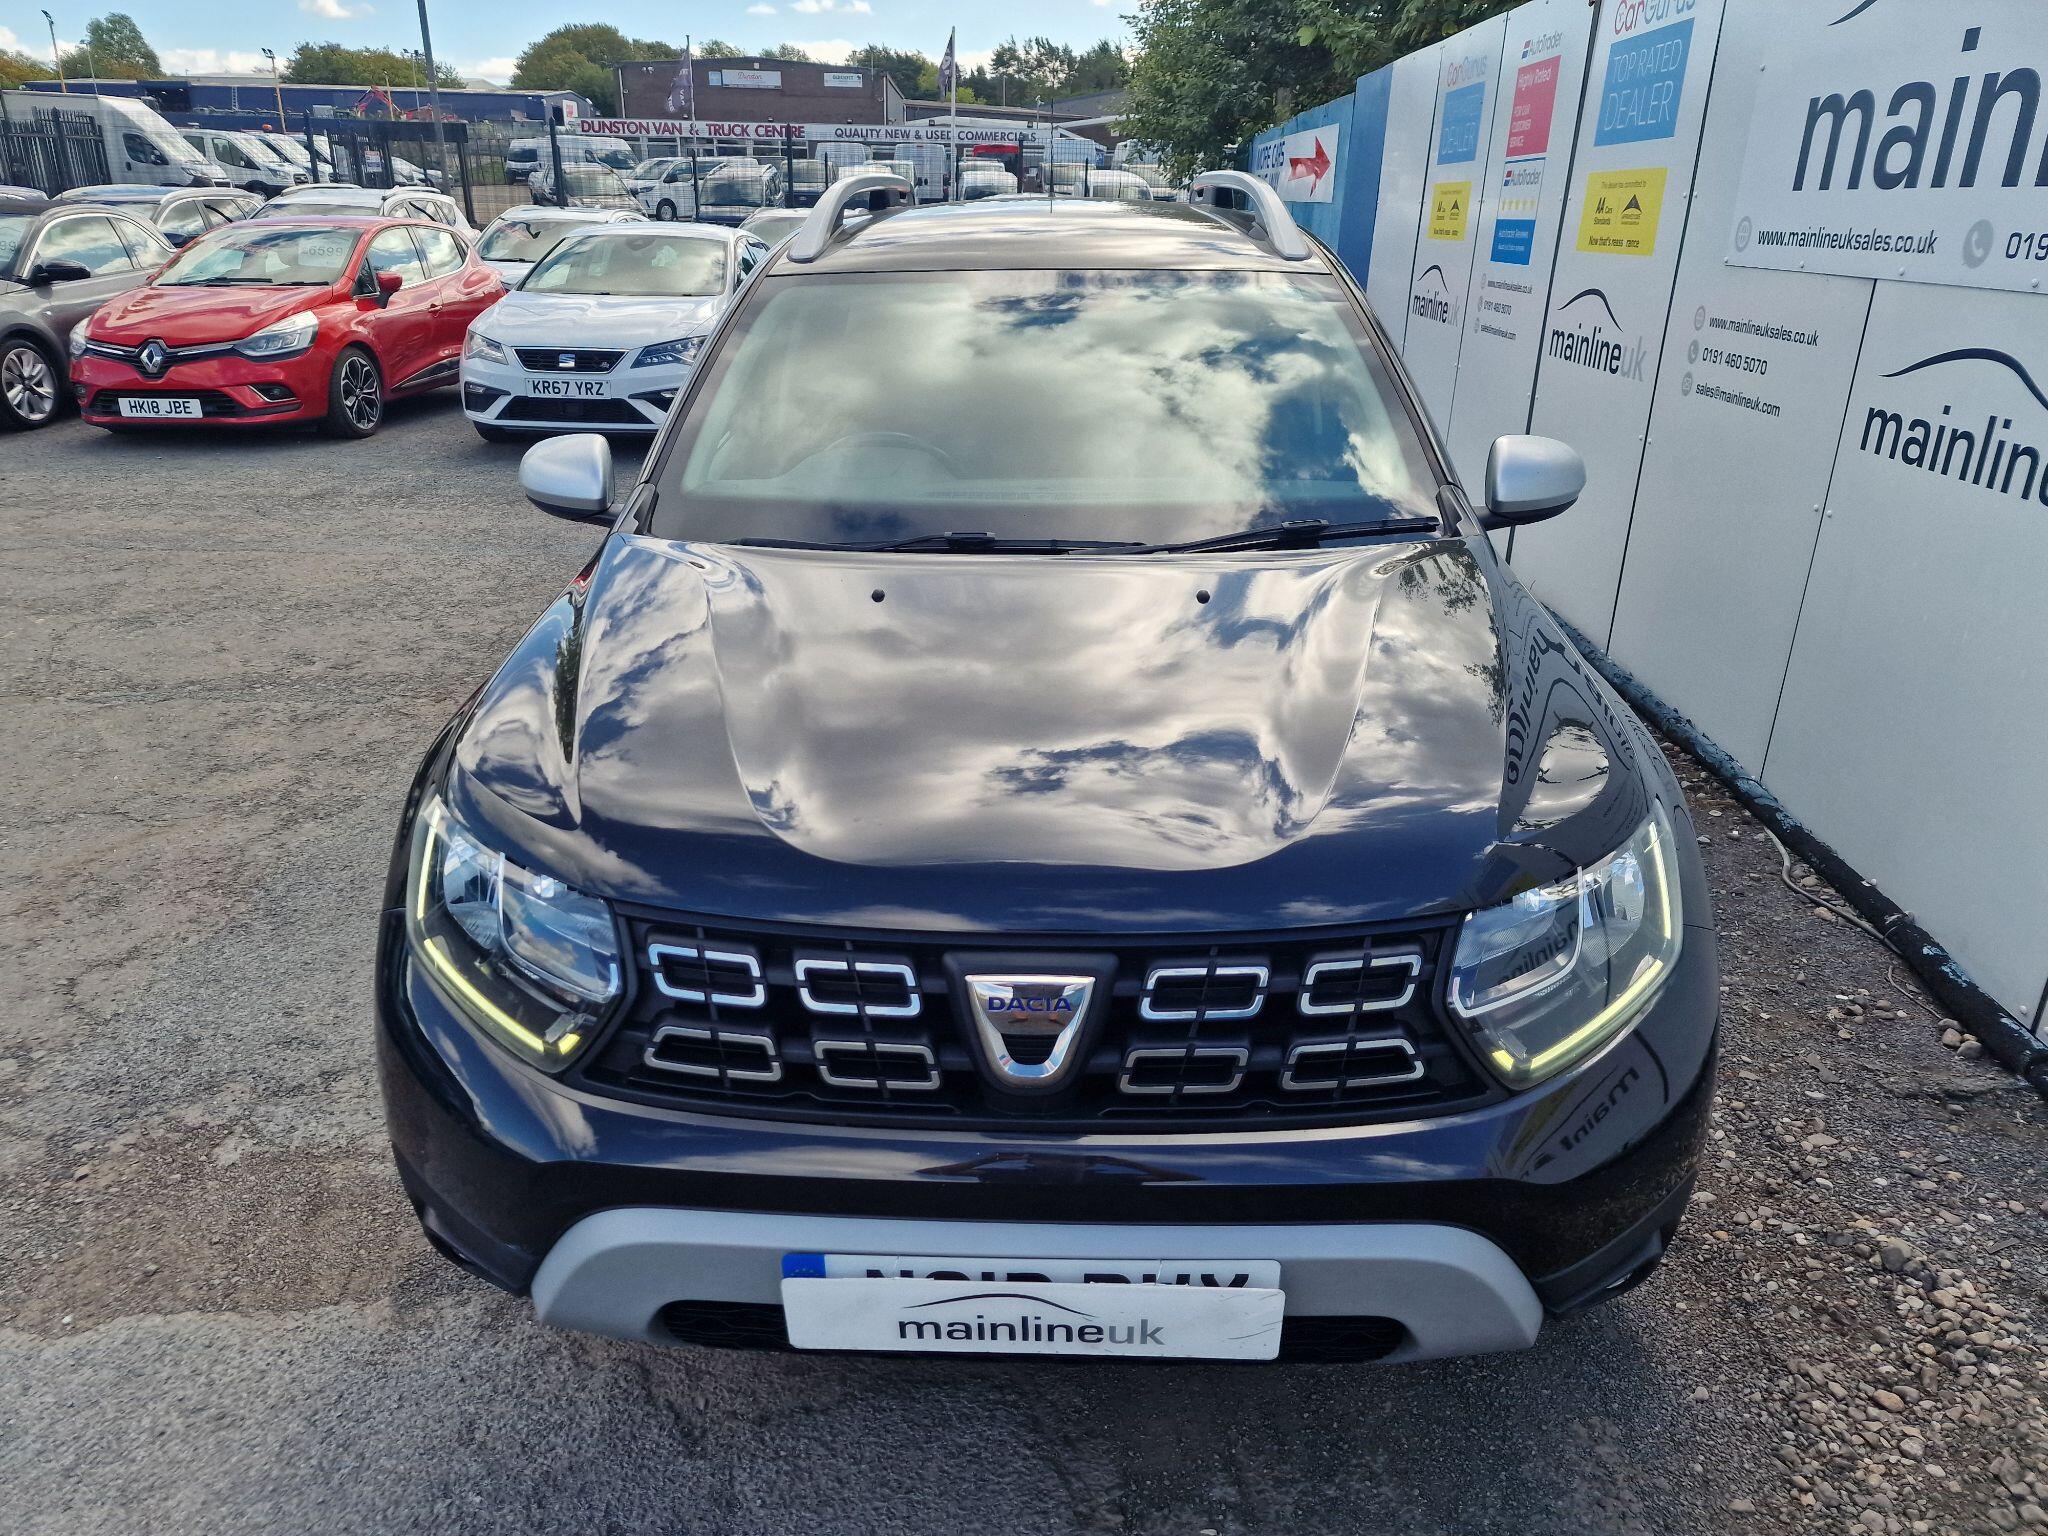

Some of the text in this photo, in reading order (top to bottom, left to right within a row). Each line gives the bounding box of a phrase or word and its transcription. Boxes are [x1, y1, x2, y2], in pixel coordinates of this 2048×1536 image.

[1612, 38, 1683, 83] TOP RATED
[1604, 80, 1674, 131] DEALER
[580, 119, 806, 139] DUNSTON VAN & TRUCK CENTRE
[834, 127, 881, 139] QUALITY
[884, 128, 911, 139] NEW
[914, 129, 922, 140] &
[925, 129, 952, 140] USED
[1757, 226, 1938, 255] www.mainlineuksales.co.uk
[1411, 288, 1461, 328] mainlineuk
[1708, 316, 1820, 347] www.mainlineuksales.co.uk
[1548, 322, 1648, 382] mainlineuk
[1702, 347, 1768, 375] 0191 460 5070
[532, 380, 605, 396] KR67 YRZ
[1695, 382, 1781, 417] sales@mainlineuk.com
[128, 399, 193, 415] HK18 JBE
[988, 996, 1072, 1012] DACIA
[898, 1314, 1166, 1346] mainlineuk
